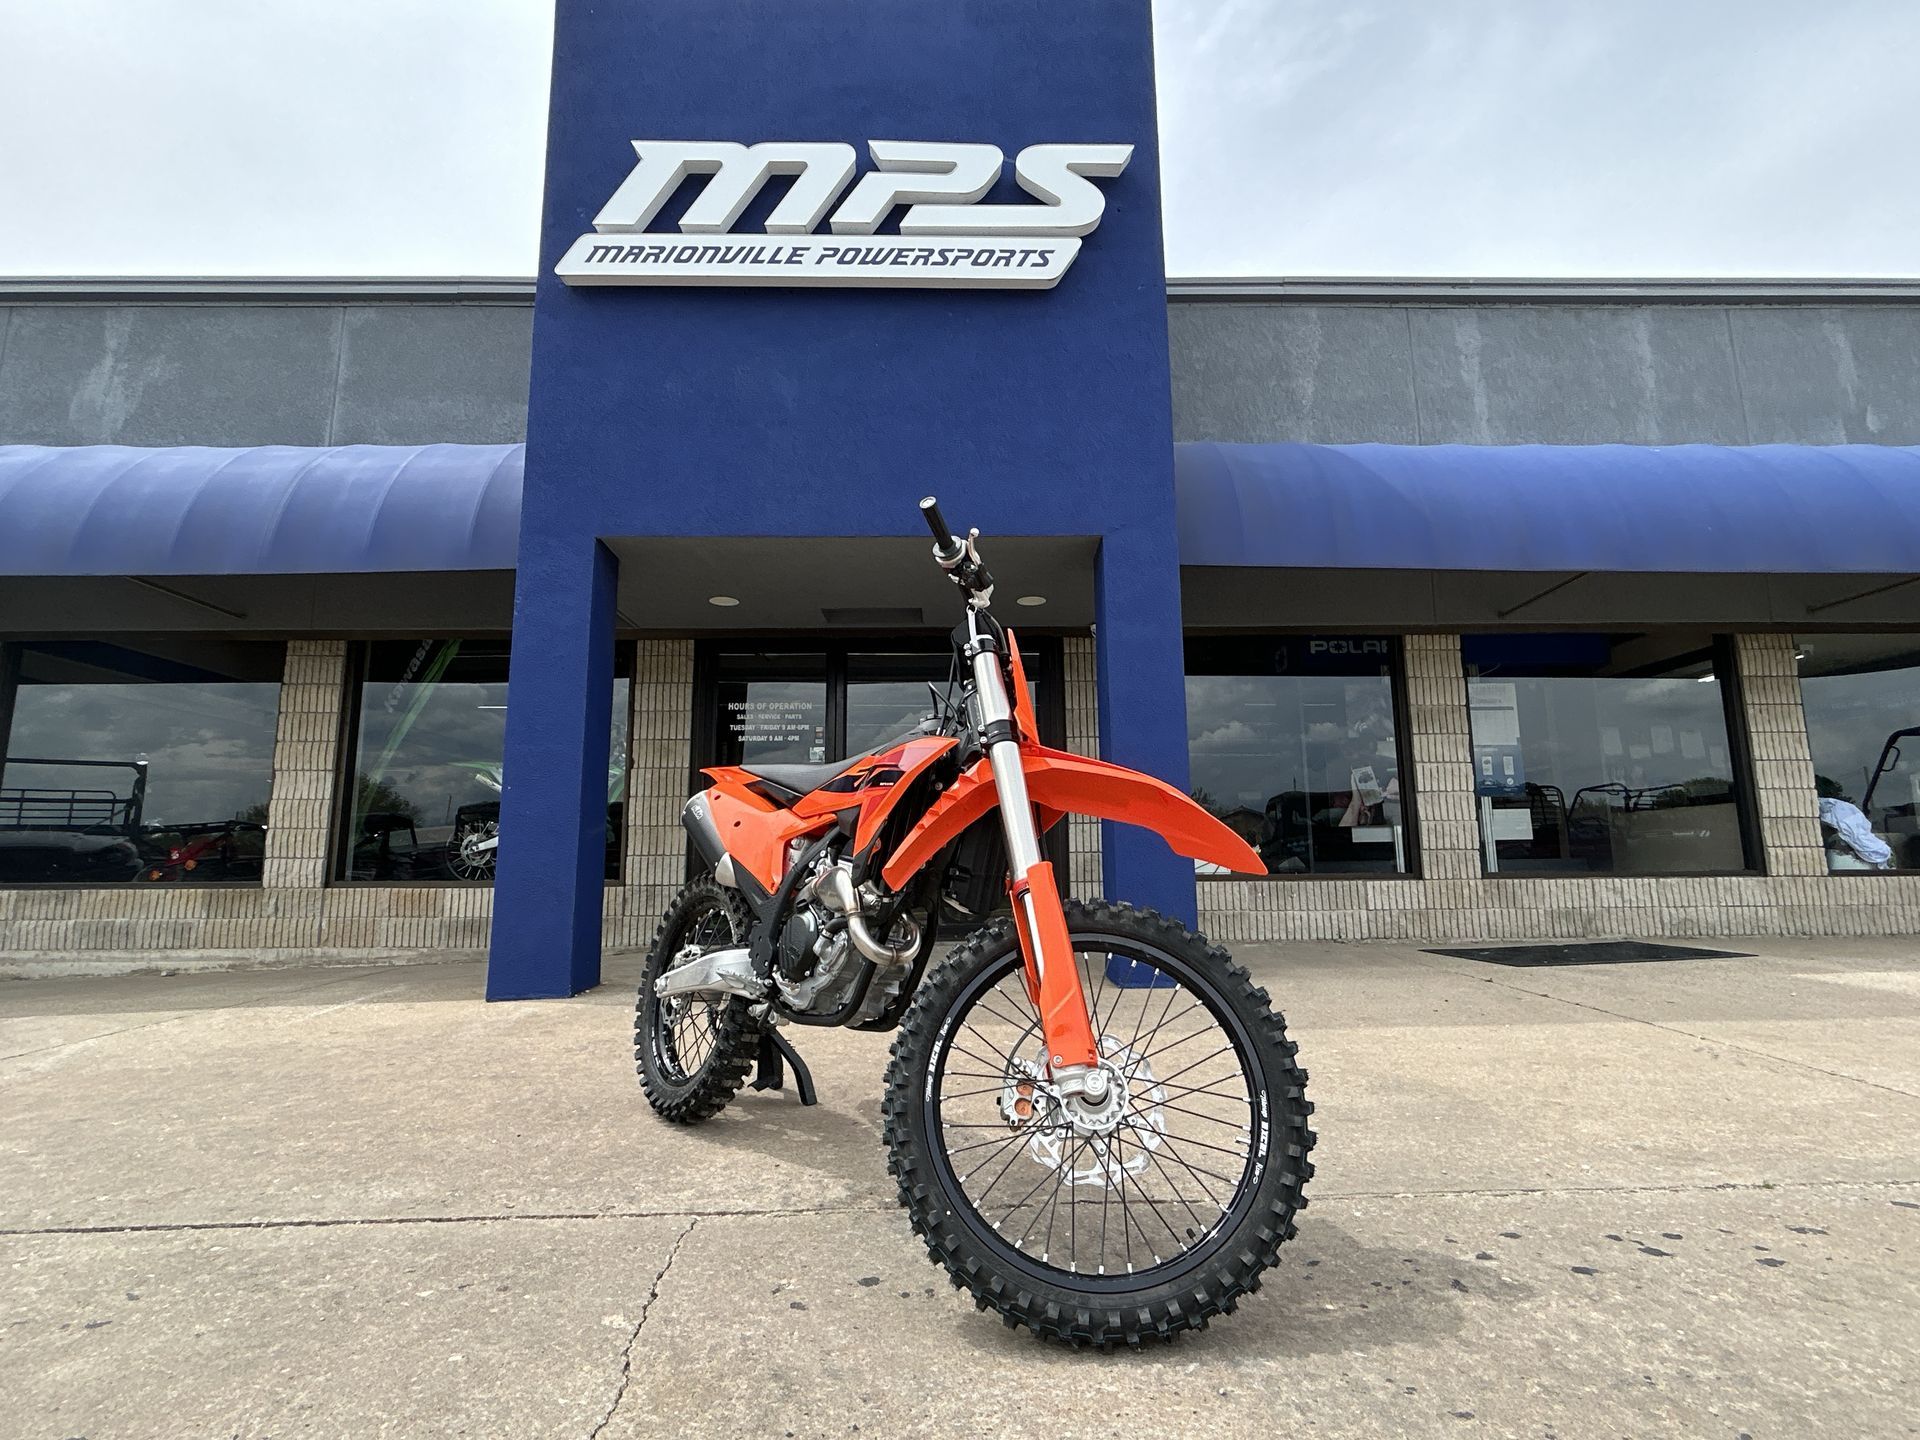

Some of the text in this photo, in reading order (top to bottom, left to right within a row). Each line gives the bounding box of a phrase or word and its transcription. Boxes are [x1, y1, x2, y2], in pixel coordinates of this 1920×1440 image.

[592, 140, 1134, 236] MPS
[584, 245, 1055, 268] MARIONVILLE POWERSPORTS
[728, 702, 812, 711] HOURS OF OPERATION
